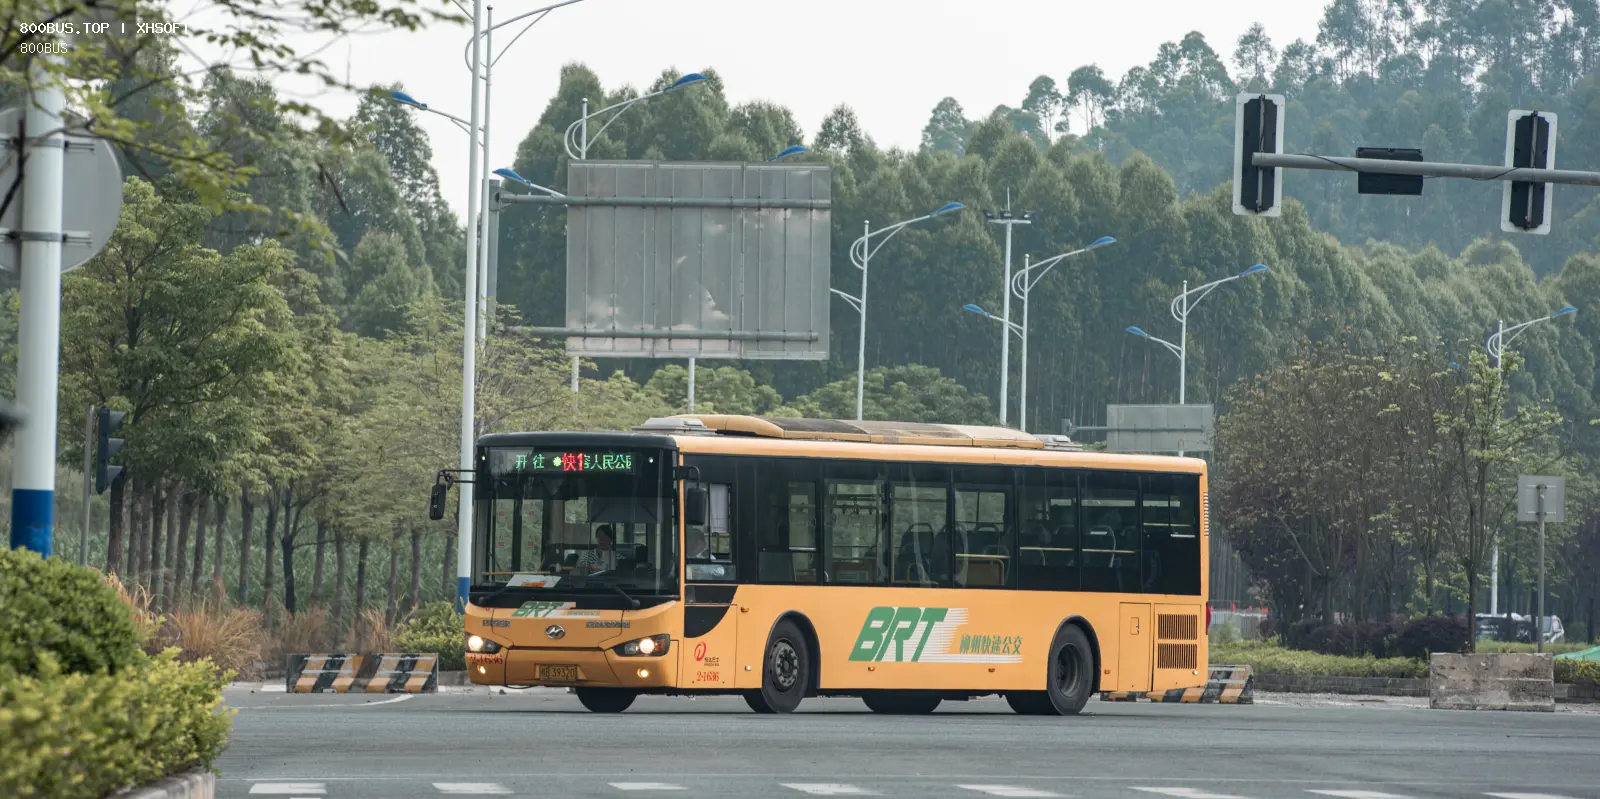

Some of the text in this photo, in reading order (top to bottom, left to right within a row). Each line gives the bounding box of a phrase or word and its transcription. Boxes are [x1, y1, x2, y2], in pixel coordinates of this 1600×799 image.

[511, 601, 565, 618] BRT
[848, 606, 949, 662] BRT
[959, 633, 1023, 655] 柳州快速公交
